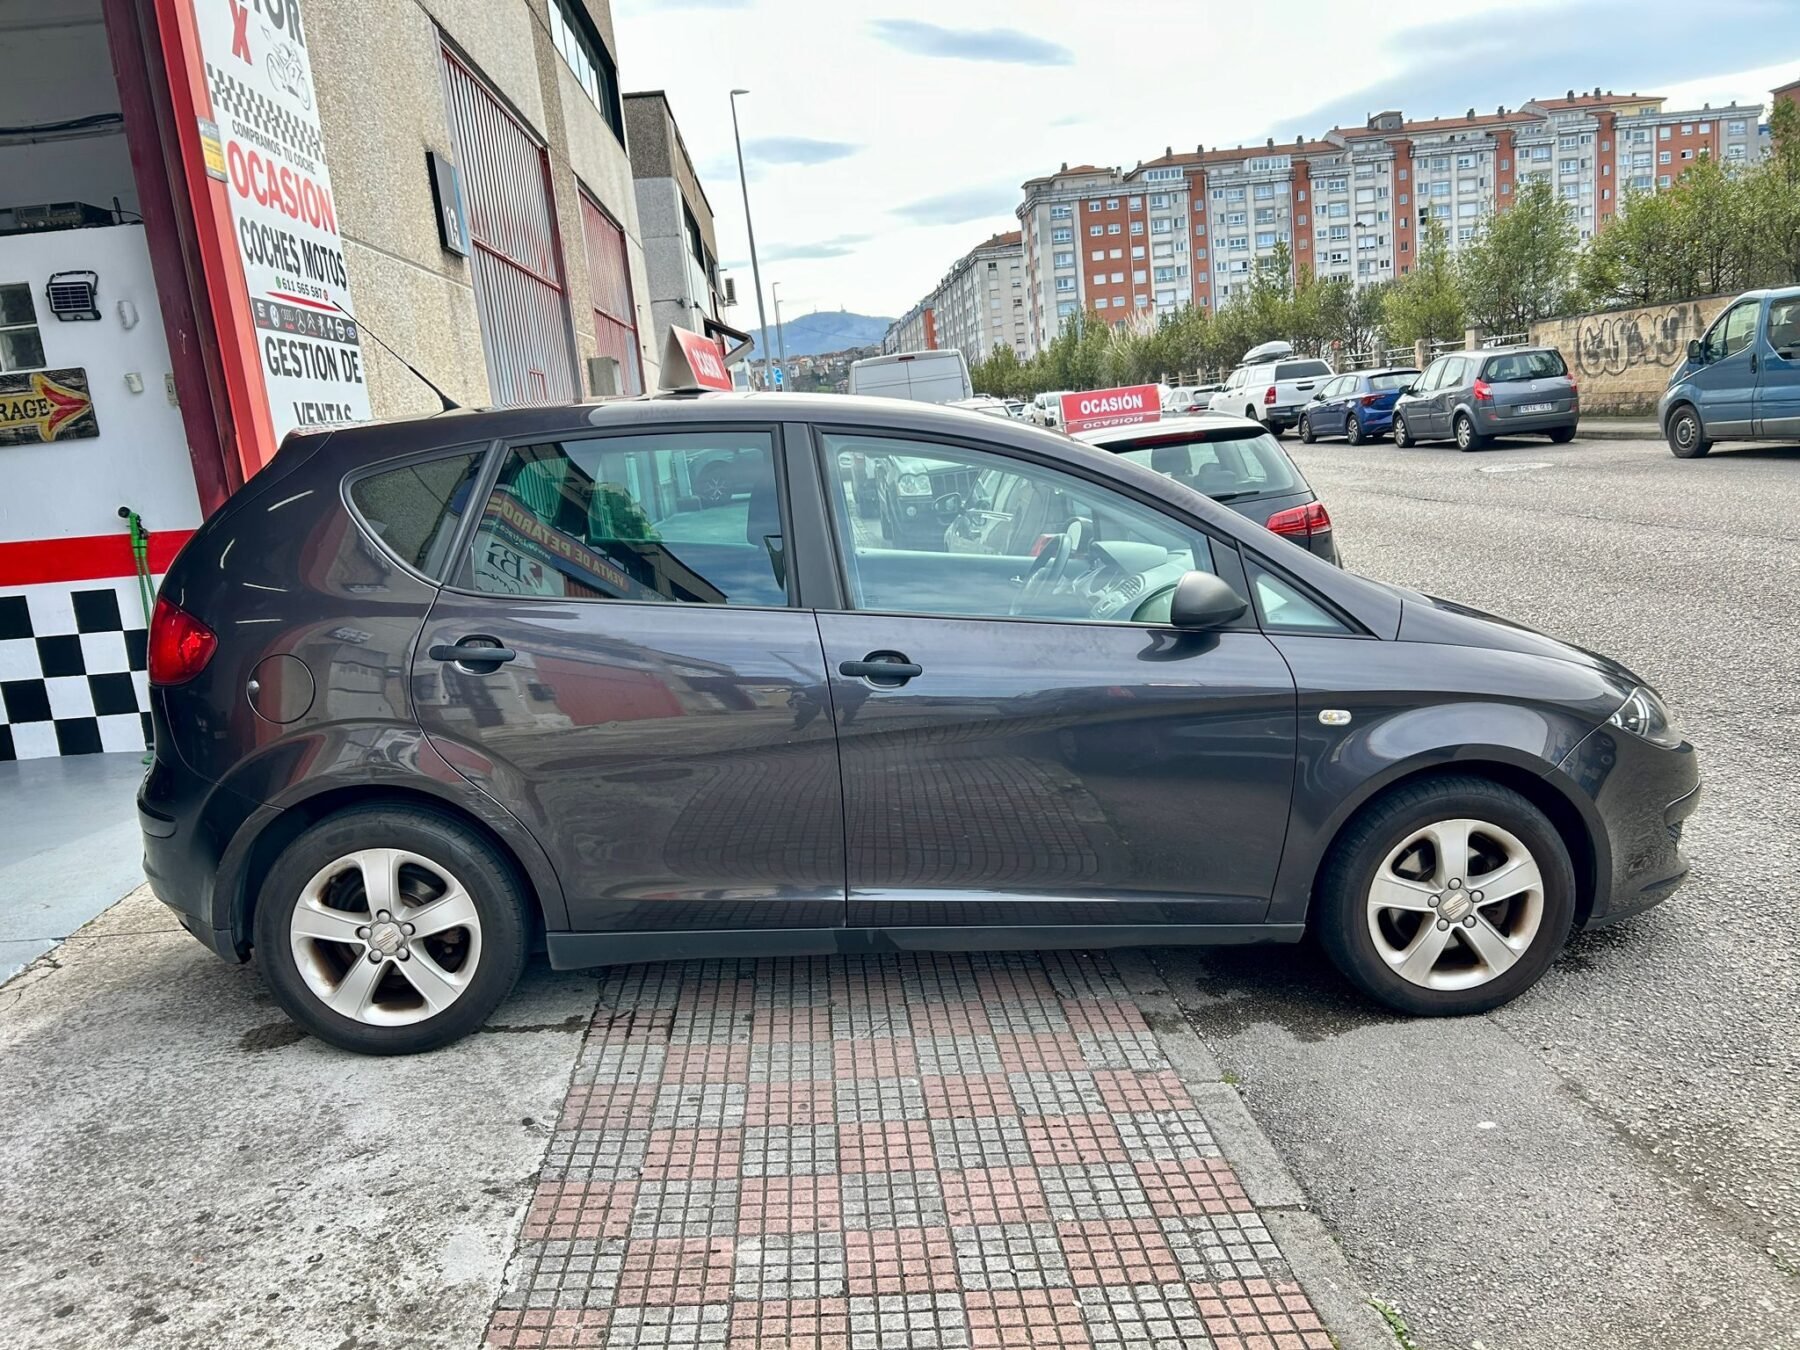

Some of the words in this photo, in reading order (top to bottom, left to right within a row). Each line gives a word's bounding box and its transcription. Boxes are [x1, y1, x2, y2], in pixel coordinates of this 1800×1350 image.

[232, 120, 281, 156] COMPRAMOS
[283, 146, 293, 163] TU
[294, 153, 316, 175] COCHE
[227, 140, 336, 235] OCASION
[240, 216, 301, 278] COCHES
[300, 239, 347, 291] MOTOS
[282, 278, 296, 292] 611
[265, 336, 340, 382] GESTION
[340, 348, 362, 384] DE
[1080, 392, 1143, 415] OCASIÓN
